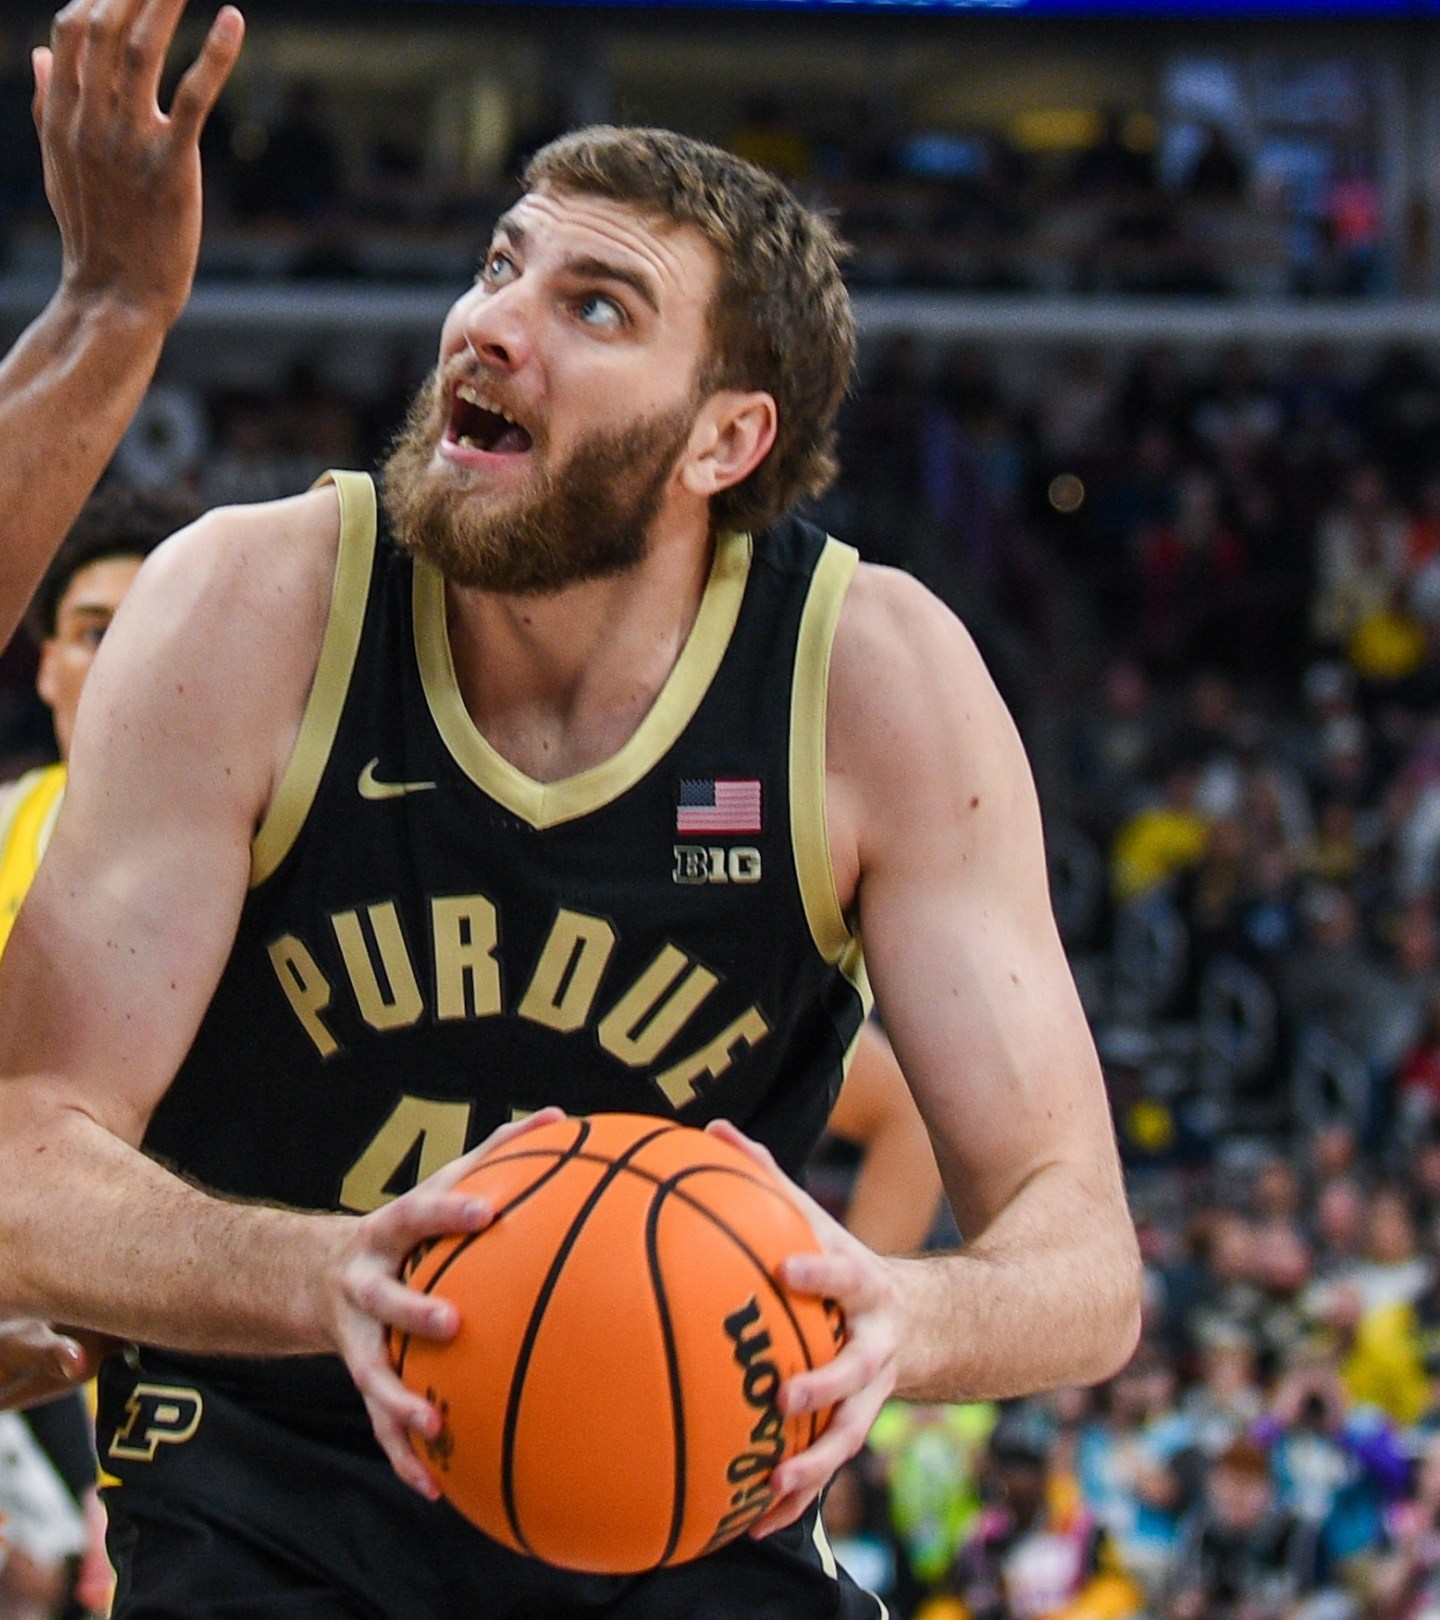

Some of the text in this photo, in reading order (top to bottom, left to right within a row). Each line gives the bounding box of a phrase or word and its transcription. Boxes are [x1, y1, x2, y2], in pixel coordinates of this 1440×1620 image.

[266, 893, 772, 1110] PURDUE
[338, 1094, 592, 1215] 4
[108, 1382, 203, 1462] P
